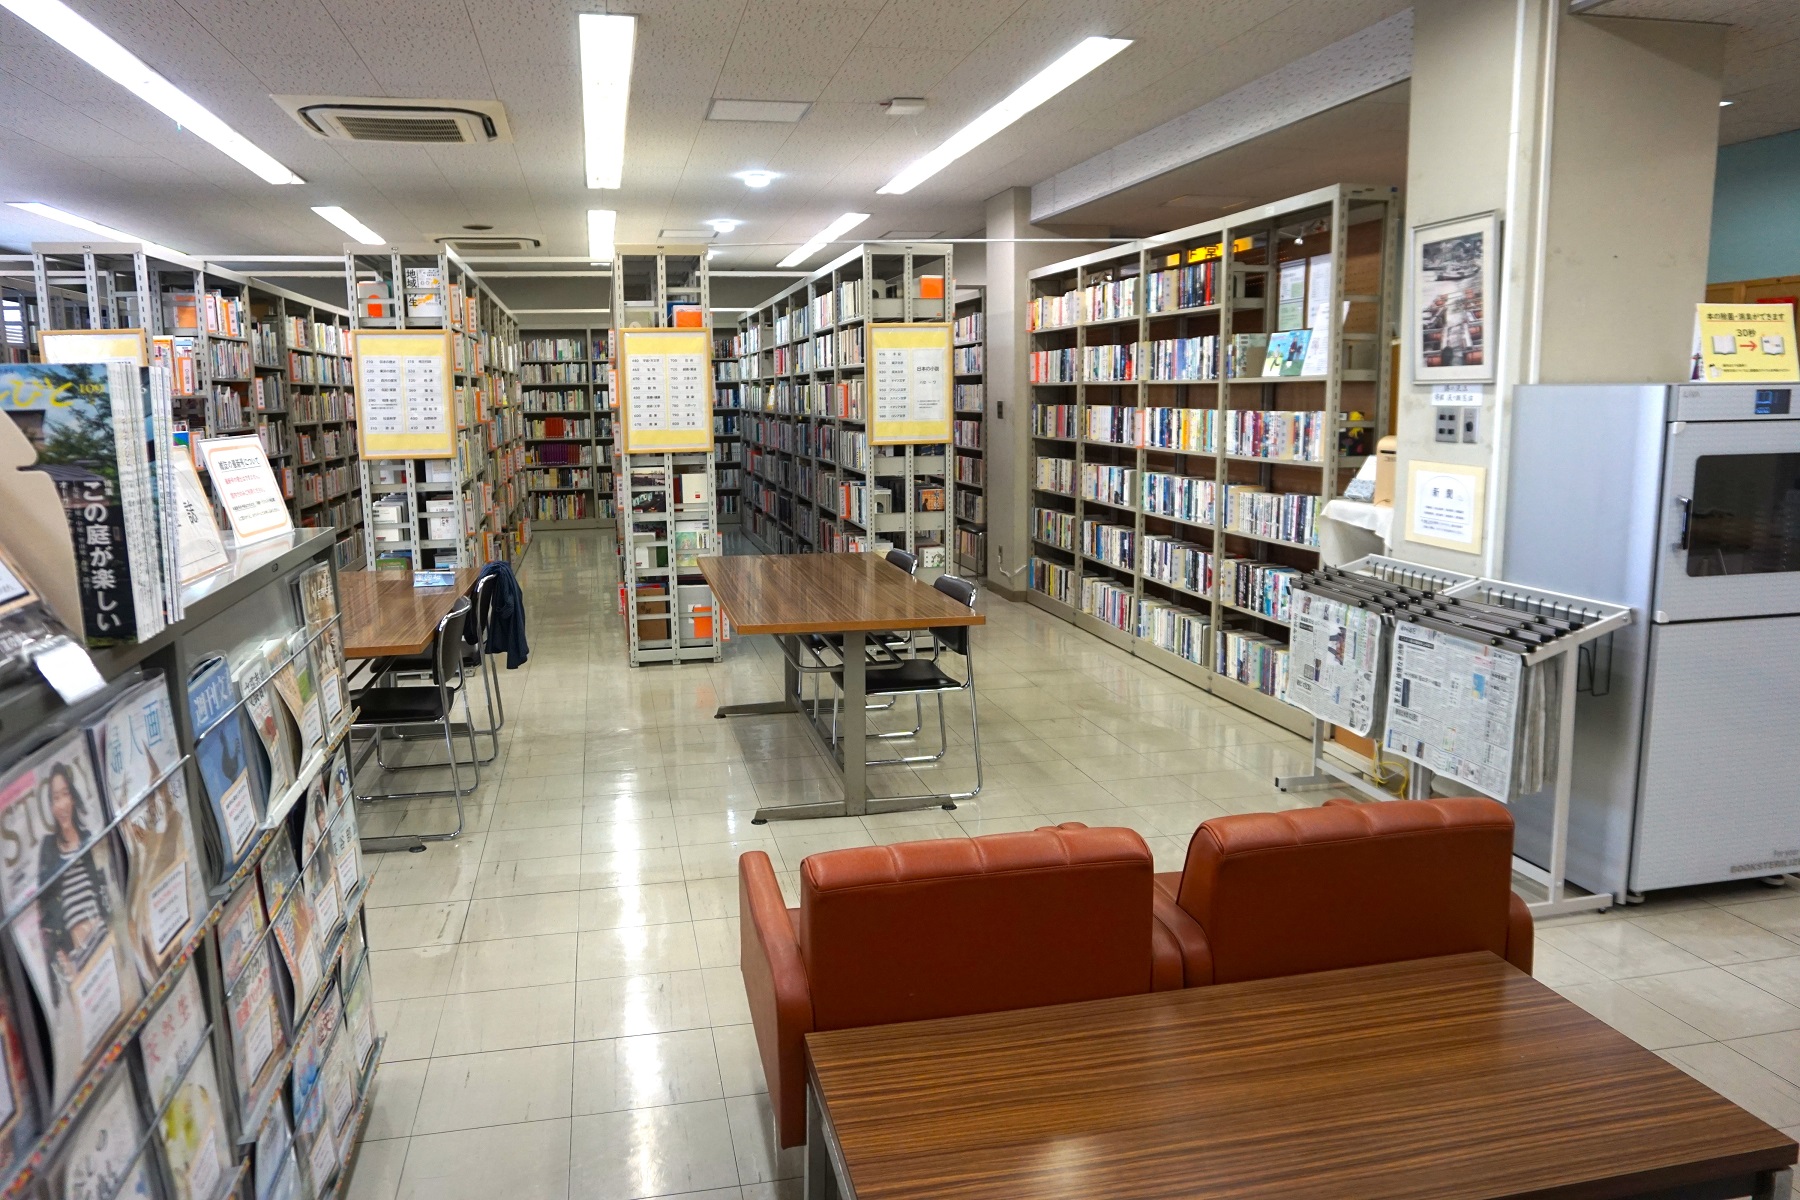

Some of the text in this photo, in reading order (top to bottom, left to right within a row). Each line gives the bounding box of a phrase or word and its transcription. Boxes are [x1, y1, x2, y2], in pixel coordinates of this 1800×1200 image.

[406, 269, 418, 307] 地域生
[1736, 329, 1757, 337] 30秒
[82, 481, 122, 631] この庭が楽しい
[0, 755, 93, 867] STOY
